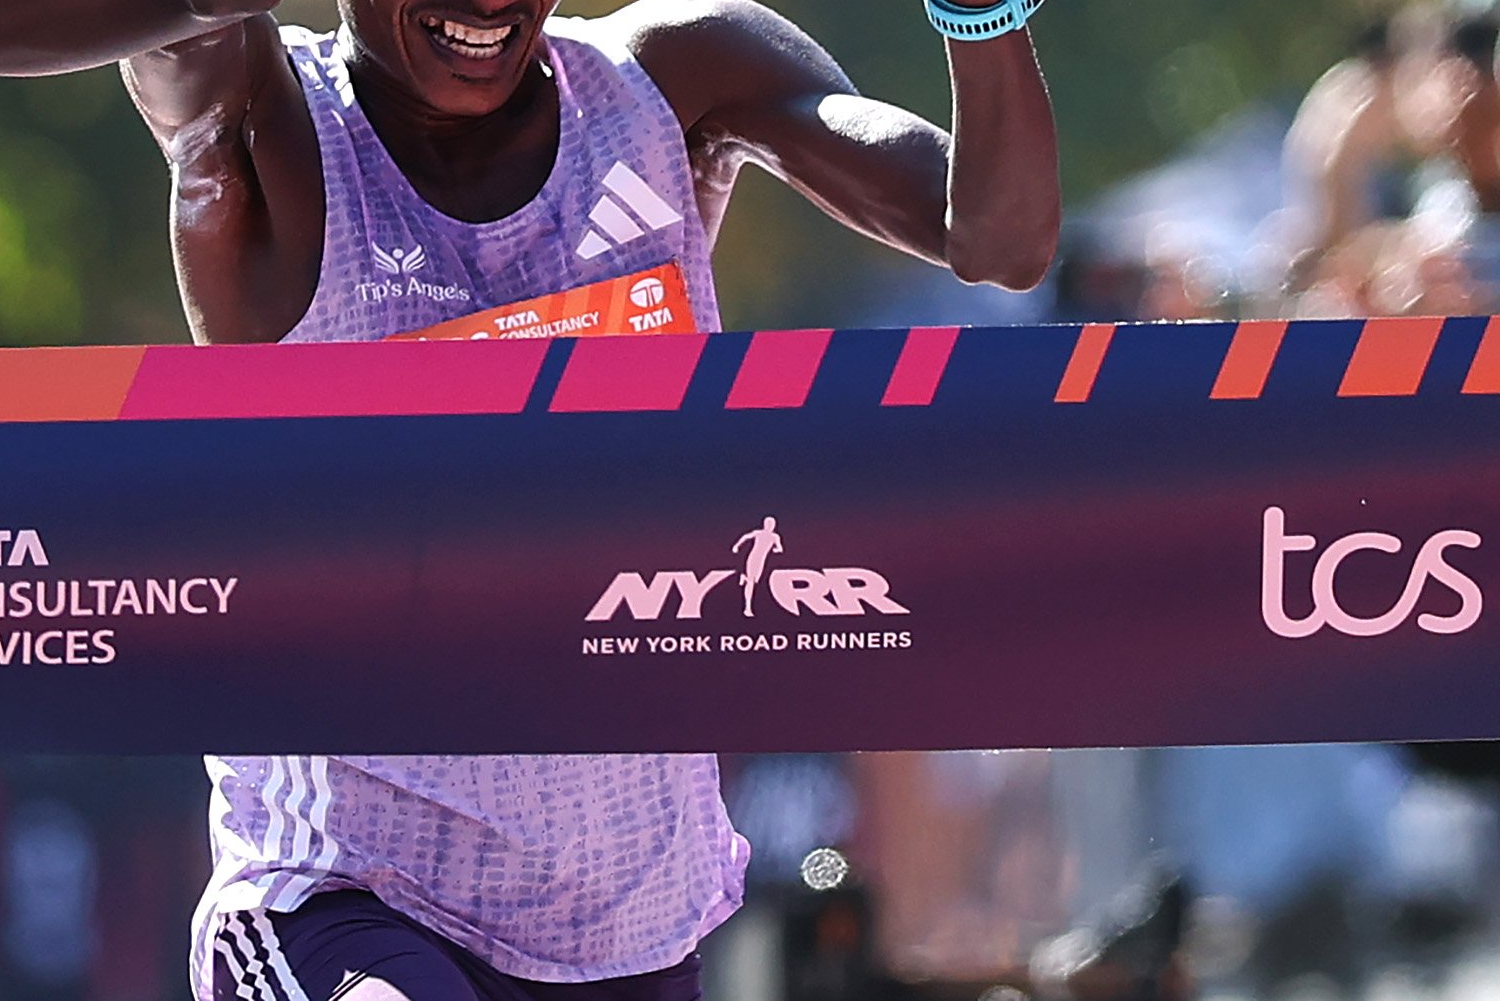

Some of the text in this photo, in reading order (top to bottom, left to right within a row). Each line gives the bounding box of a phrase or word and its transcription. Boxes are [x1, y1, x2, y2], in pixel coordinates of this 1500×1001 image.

[406, 276, 470, 301] Angels
[494, 310, 540, 330] TATA
[629, 307, 674, 333] TATA
[1262, 506, 1483, 638] tcs
[582, 631, 912, 654] NEW YORK ROAD RUNNERS
